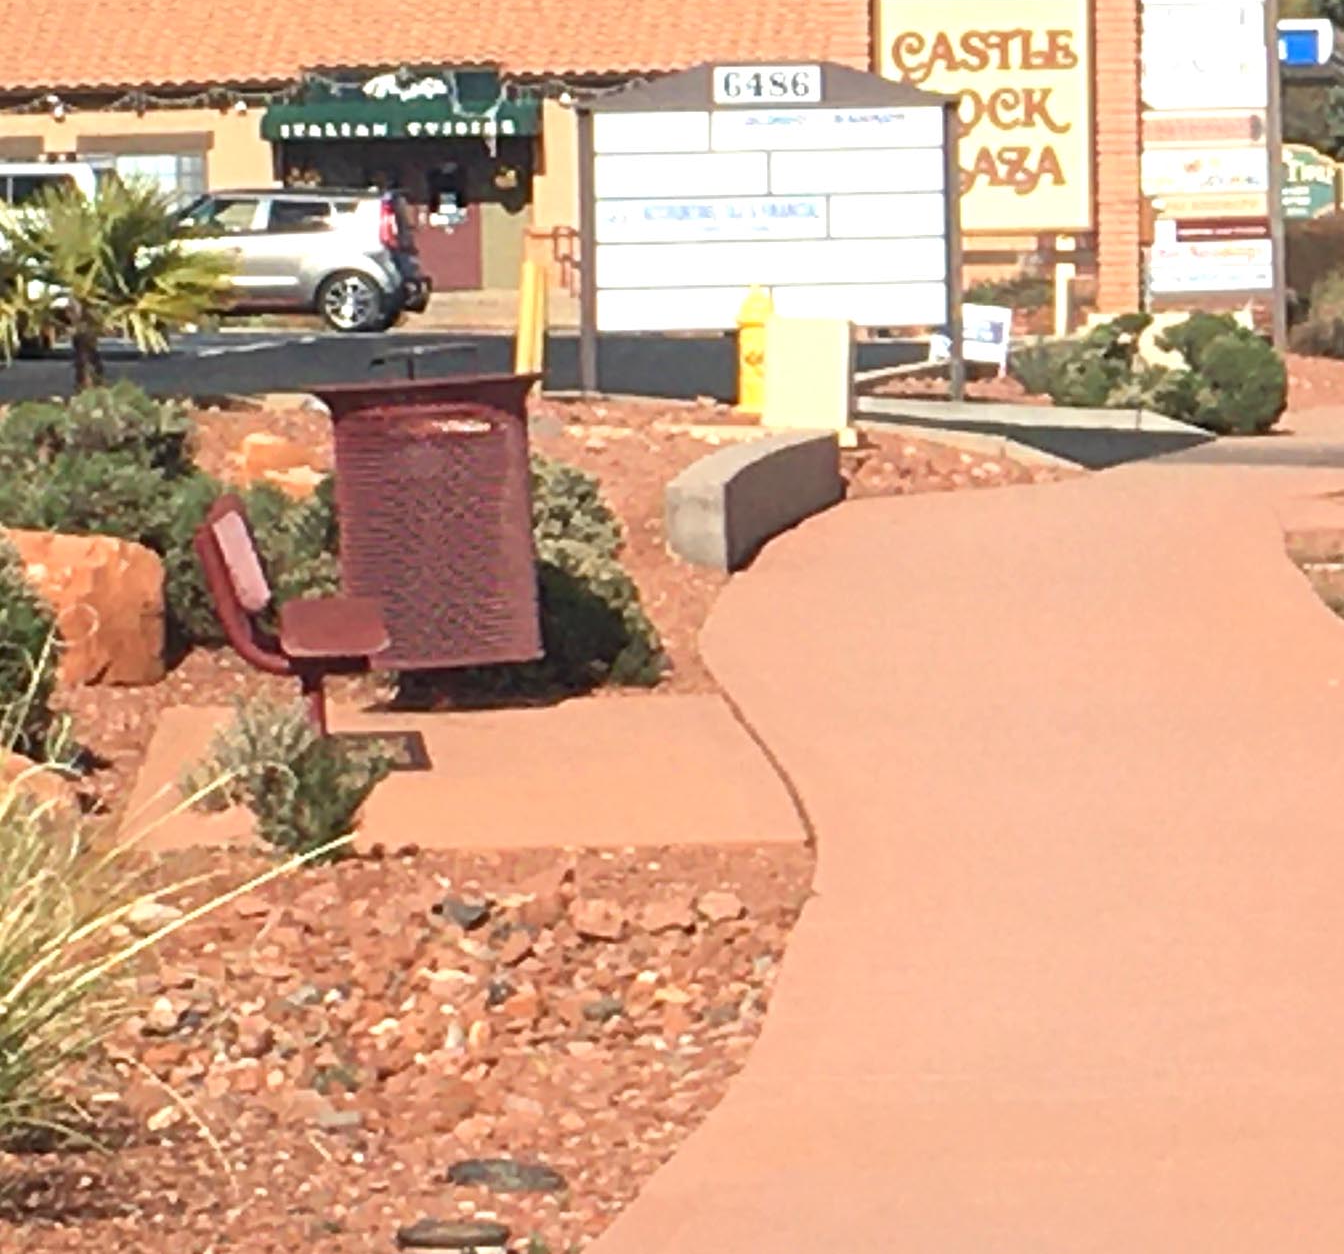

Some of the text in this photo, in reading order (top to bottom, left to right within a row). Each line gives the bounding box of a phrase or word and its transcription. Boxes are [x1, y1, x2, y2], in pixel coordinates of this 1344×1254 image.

[891, 28, 1079, 85] CASTLE
[723, 71, 811, 97] 6486
[957, 87, 1073, 138] OCK
[958, 146, 1067, 196] AZA
